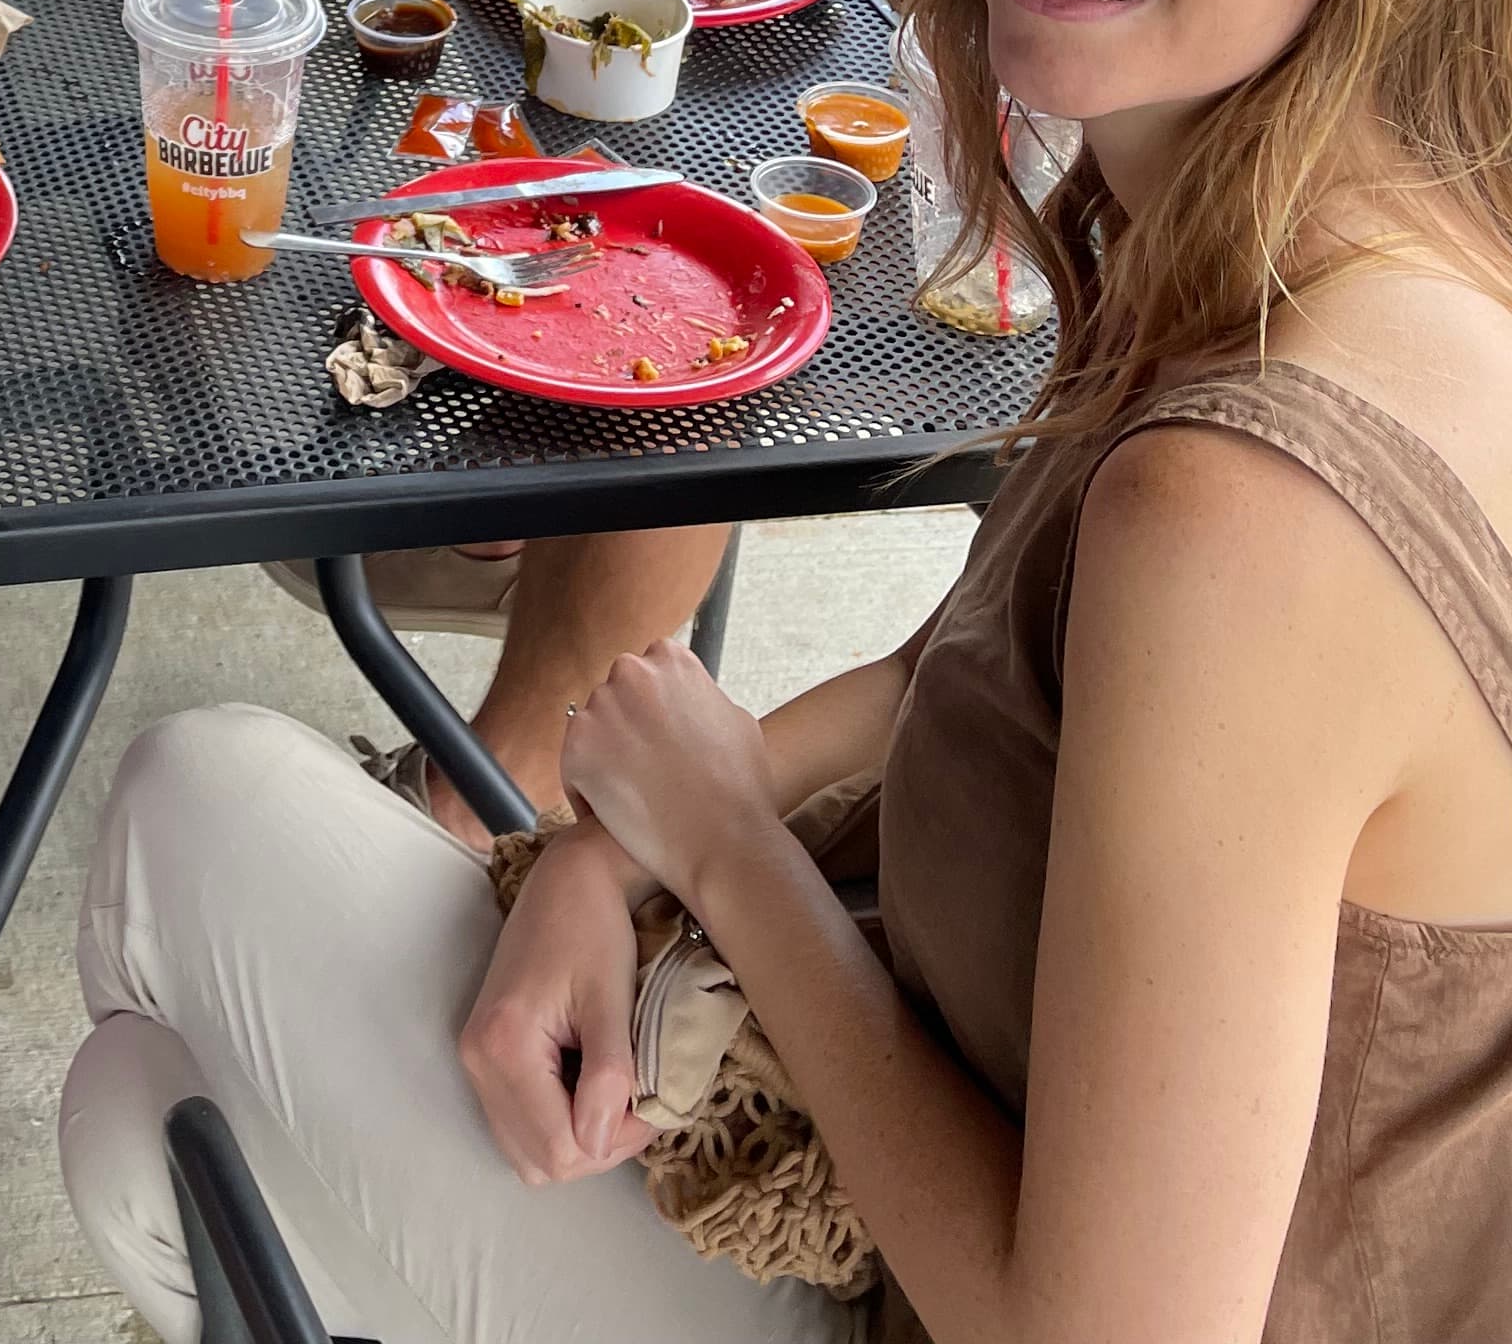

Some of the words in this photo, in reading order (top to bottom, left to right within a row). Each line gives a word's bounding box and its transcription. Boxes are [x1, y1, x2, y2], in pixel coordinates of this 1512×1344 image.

[158, 135, 273, 178] BARBEQUE
[182, 116, 248, 162] City
[182, 181, 246, 201] #citybbq
